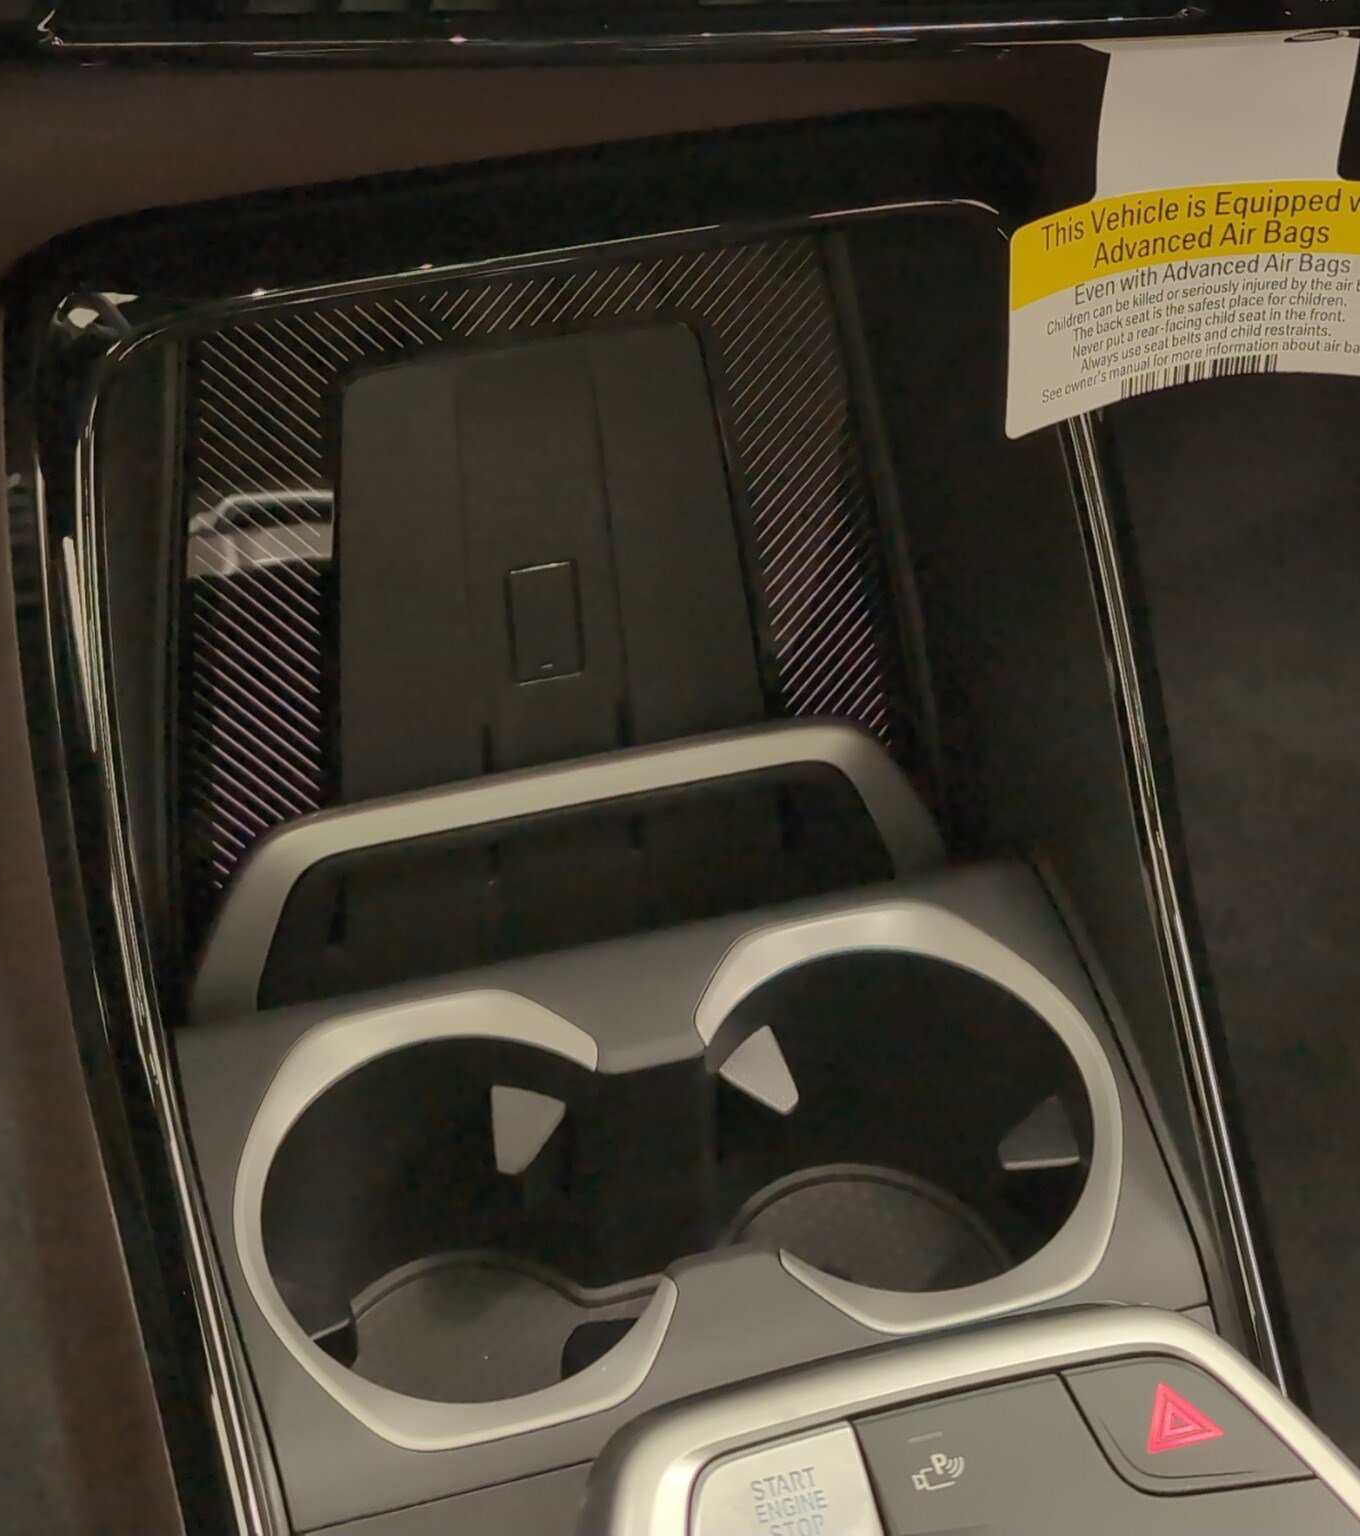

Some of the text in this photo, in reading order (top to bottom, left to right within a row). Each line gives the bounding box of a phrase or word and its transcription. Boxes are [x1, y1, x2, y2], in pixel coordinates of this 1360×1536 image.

[1040, 217, 1085, 251] This
[1090, 197, 1179, 234] Vehicle
[1186, 193, 1207, 219] is
[1214, 187, 1342, 219] Equipped
[1093, 219, 1330, 269] Advanced Air Bags
[1074, 252, 1351, 306] Even with Advanced Air Bags
[1046, 311, 1090, 336] Children
[1093, 303, 1113, 319] can
[1115, 297, 1130, 313] be
[1132, 288, 1164, 308] killed
[1166, 288, 1181, 301] or
[1182, 278, 1239, 298] seriously
[1242, 277, 1288, 295] injured
[1290, 278, 1307, 296] by
[1310, 278, 1332, 291] the
[1335, 278, 1354, 292] air
[1073, 291, 1348, 343] The back seat is the safest place for children.
[1072, 308, 1347, 360] Never put a rear-facing child seat in the front.
[1080, 322, 1332, 374] Always use seat belts and child restraints.
[1041, 387, 1063, 404] See
[1064, 370, 1108, 395] owner's
[1109, 359, 1150, 380] manual
[1152, 353, 1169, 369] for
[1171, 345, 1203, 363] more
[1205, 340, 1279, 357] information
[1281, 338, 1321, 352] about
[1323, 339, 1341, 352] air
[750, 1467, 816, 1501] START
[754, 1490, 828, 1524] ENGINE
